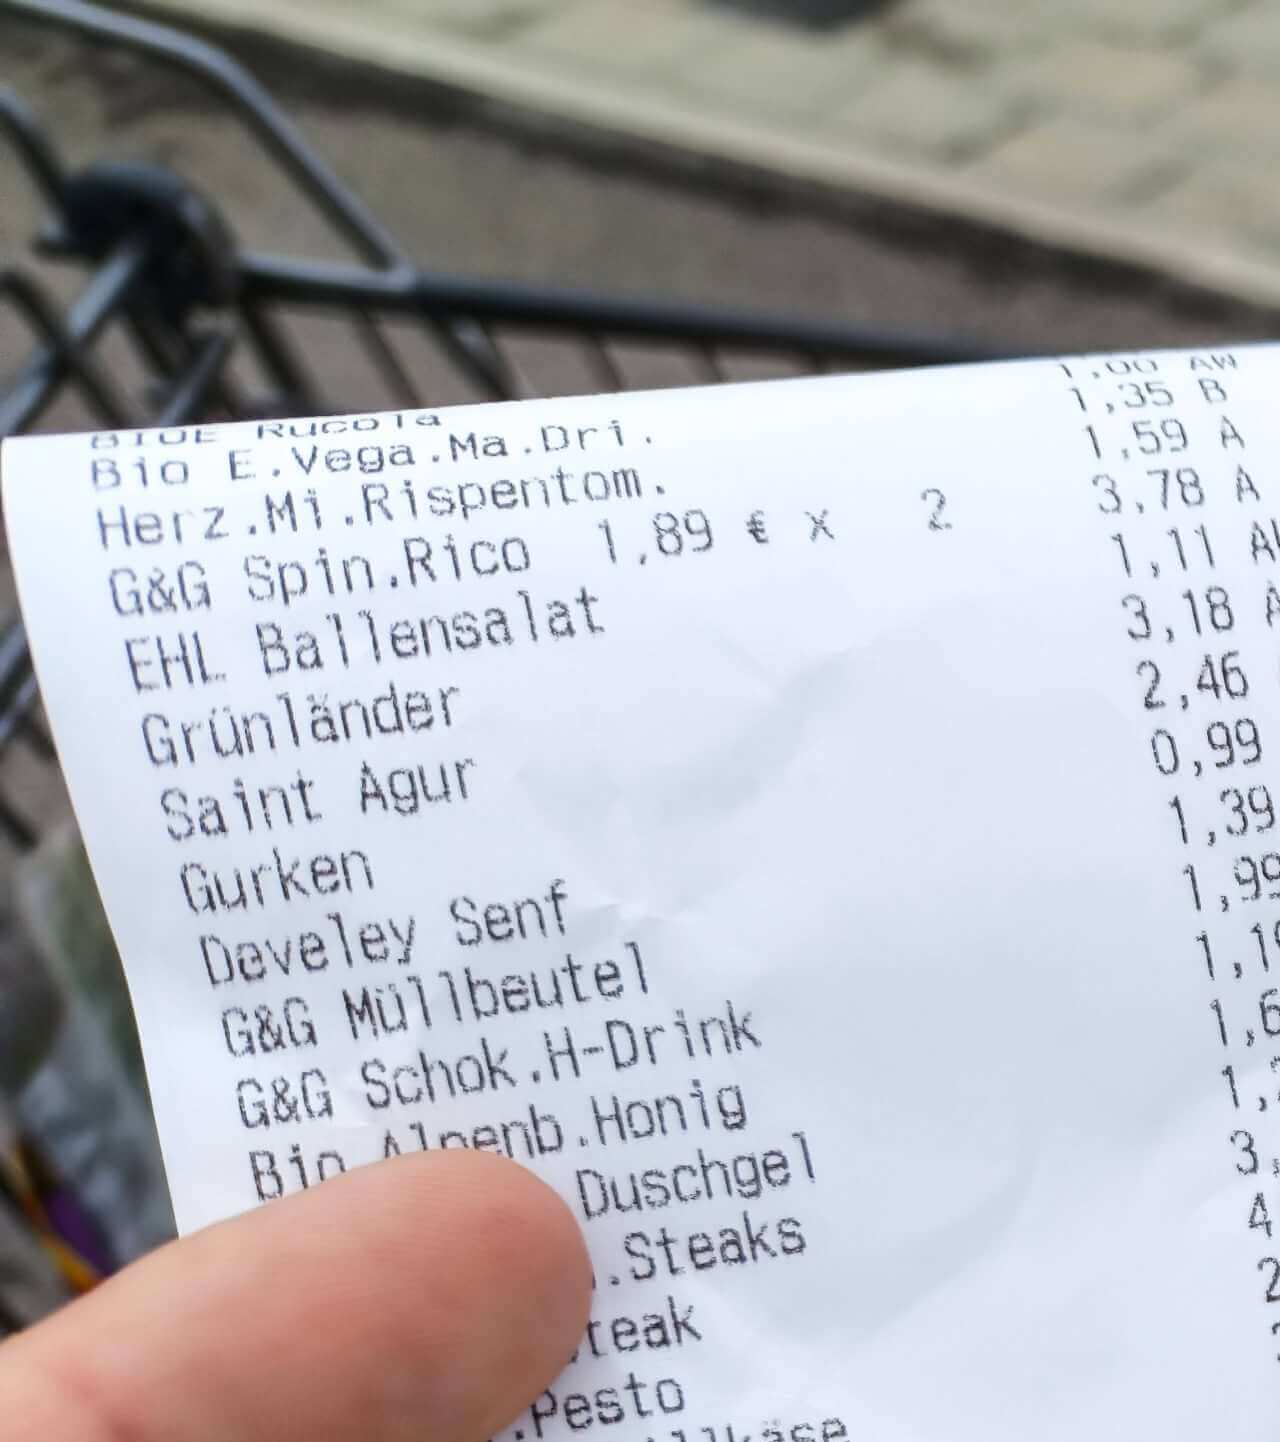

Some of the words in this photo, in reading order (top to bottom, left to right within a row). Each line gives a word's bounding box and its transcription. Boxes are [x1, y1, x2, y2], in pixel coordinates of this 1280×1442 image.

[91, 454, 190, 490] Bio
[228, 420, 651, 481] E.Vega.Ma.Dri.
[1068, 382, 1175, 415] 1,35
[1198, 377, 1228, 404] B
[97, 466, 665, 550] Herz.Mi.Rispentom.
[1085, 419, 1188, 459] 1,59
[1218, 414, 1246, 449] A
[109, 561, 211, 616] G&G
[244, 534, 530, 606] Spin.Rico
[598, 509, 714, 565] 1,89
[746, 510, 769, 544] €
[921, 488, 952, 531] 2
[1092, 468, 1205, 514] 3,78
[1236, 465, 1260, 503] A
[125, 631, 226, 694] EHL
[255, 586, 605, 678] Ballensalat
[1111, 524, 1215, 578] 1,11
[141, 681, 459, 768] Grünländer
[1121, 586, 1234, 643] 3,18
[160, 770, 322, 842] Saint
[360, 758, 475, 817] Agur
[1136, 650, 1249, 711] 2,46
[180, 847, 374, 915] Gurken
[1150, 718, 1262, 777] 0,99
[199, 912, 415, 989] Develey
[449, 878, 567, 947] Senf
[1168, 785, 1276, 847] 1,39
[221, 997, 318, 1057] G&G
[342, 941, 648, 1040] Müllbeutel
[236, 1068, 333, 1129] G&G
[360, 1000, 762, 1110] Schok.H-Drink
[571, 1296, 702, 1362] teak
